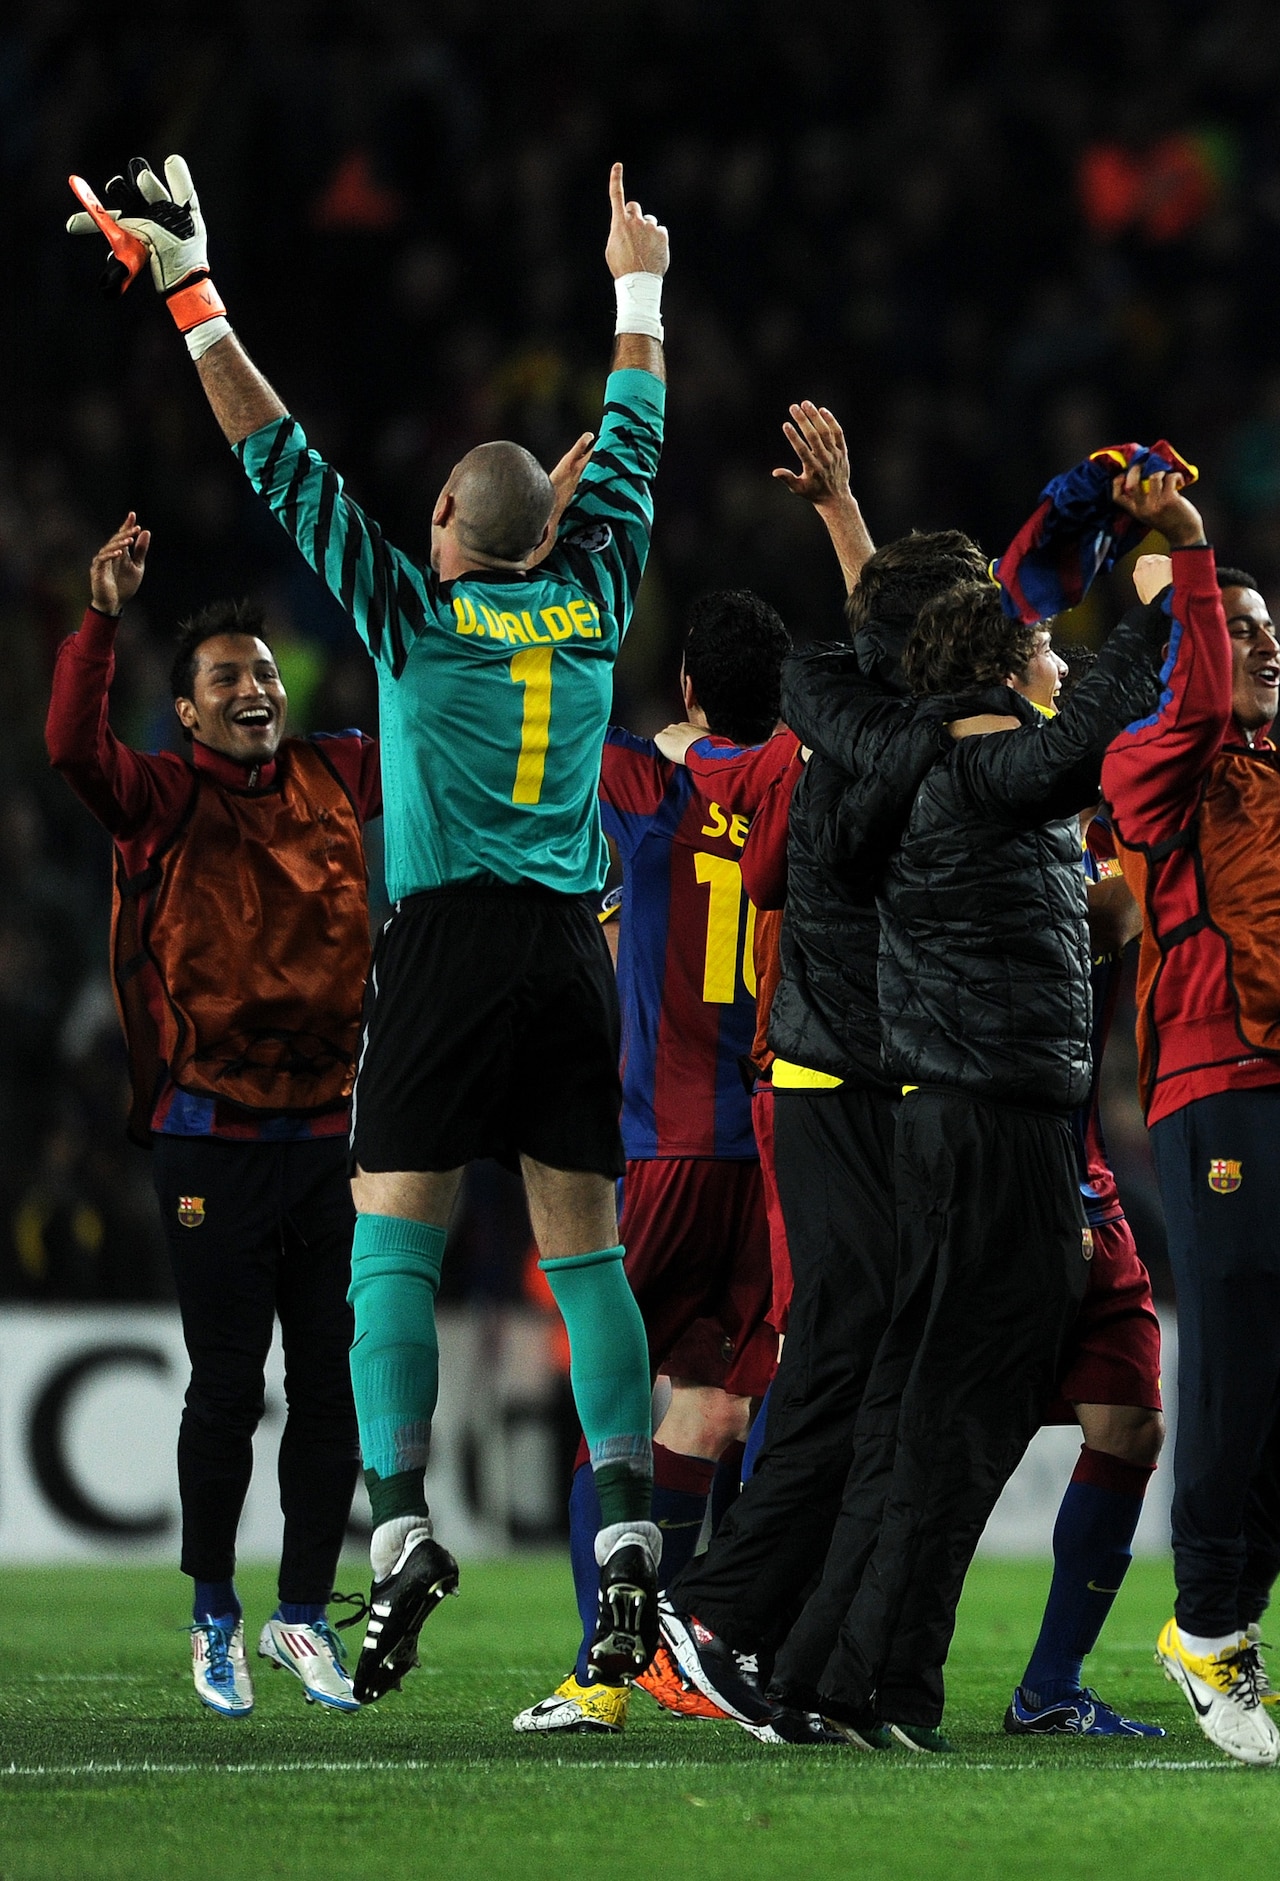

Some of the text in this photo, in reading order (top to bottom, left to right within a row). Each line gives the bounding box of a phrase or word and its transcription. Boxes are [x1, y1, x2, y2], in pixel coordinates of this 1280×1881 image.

[510, 647, 554, 804] 1
[701, 801, 749, 848] SE
[693, 851, 757, 1004] 1
